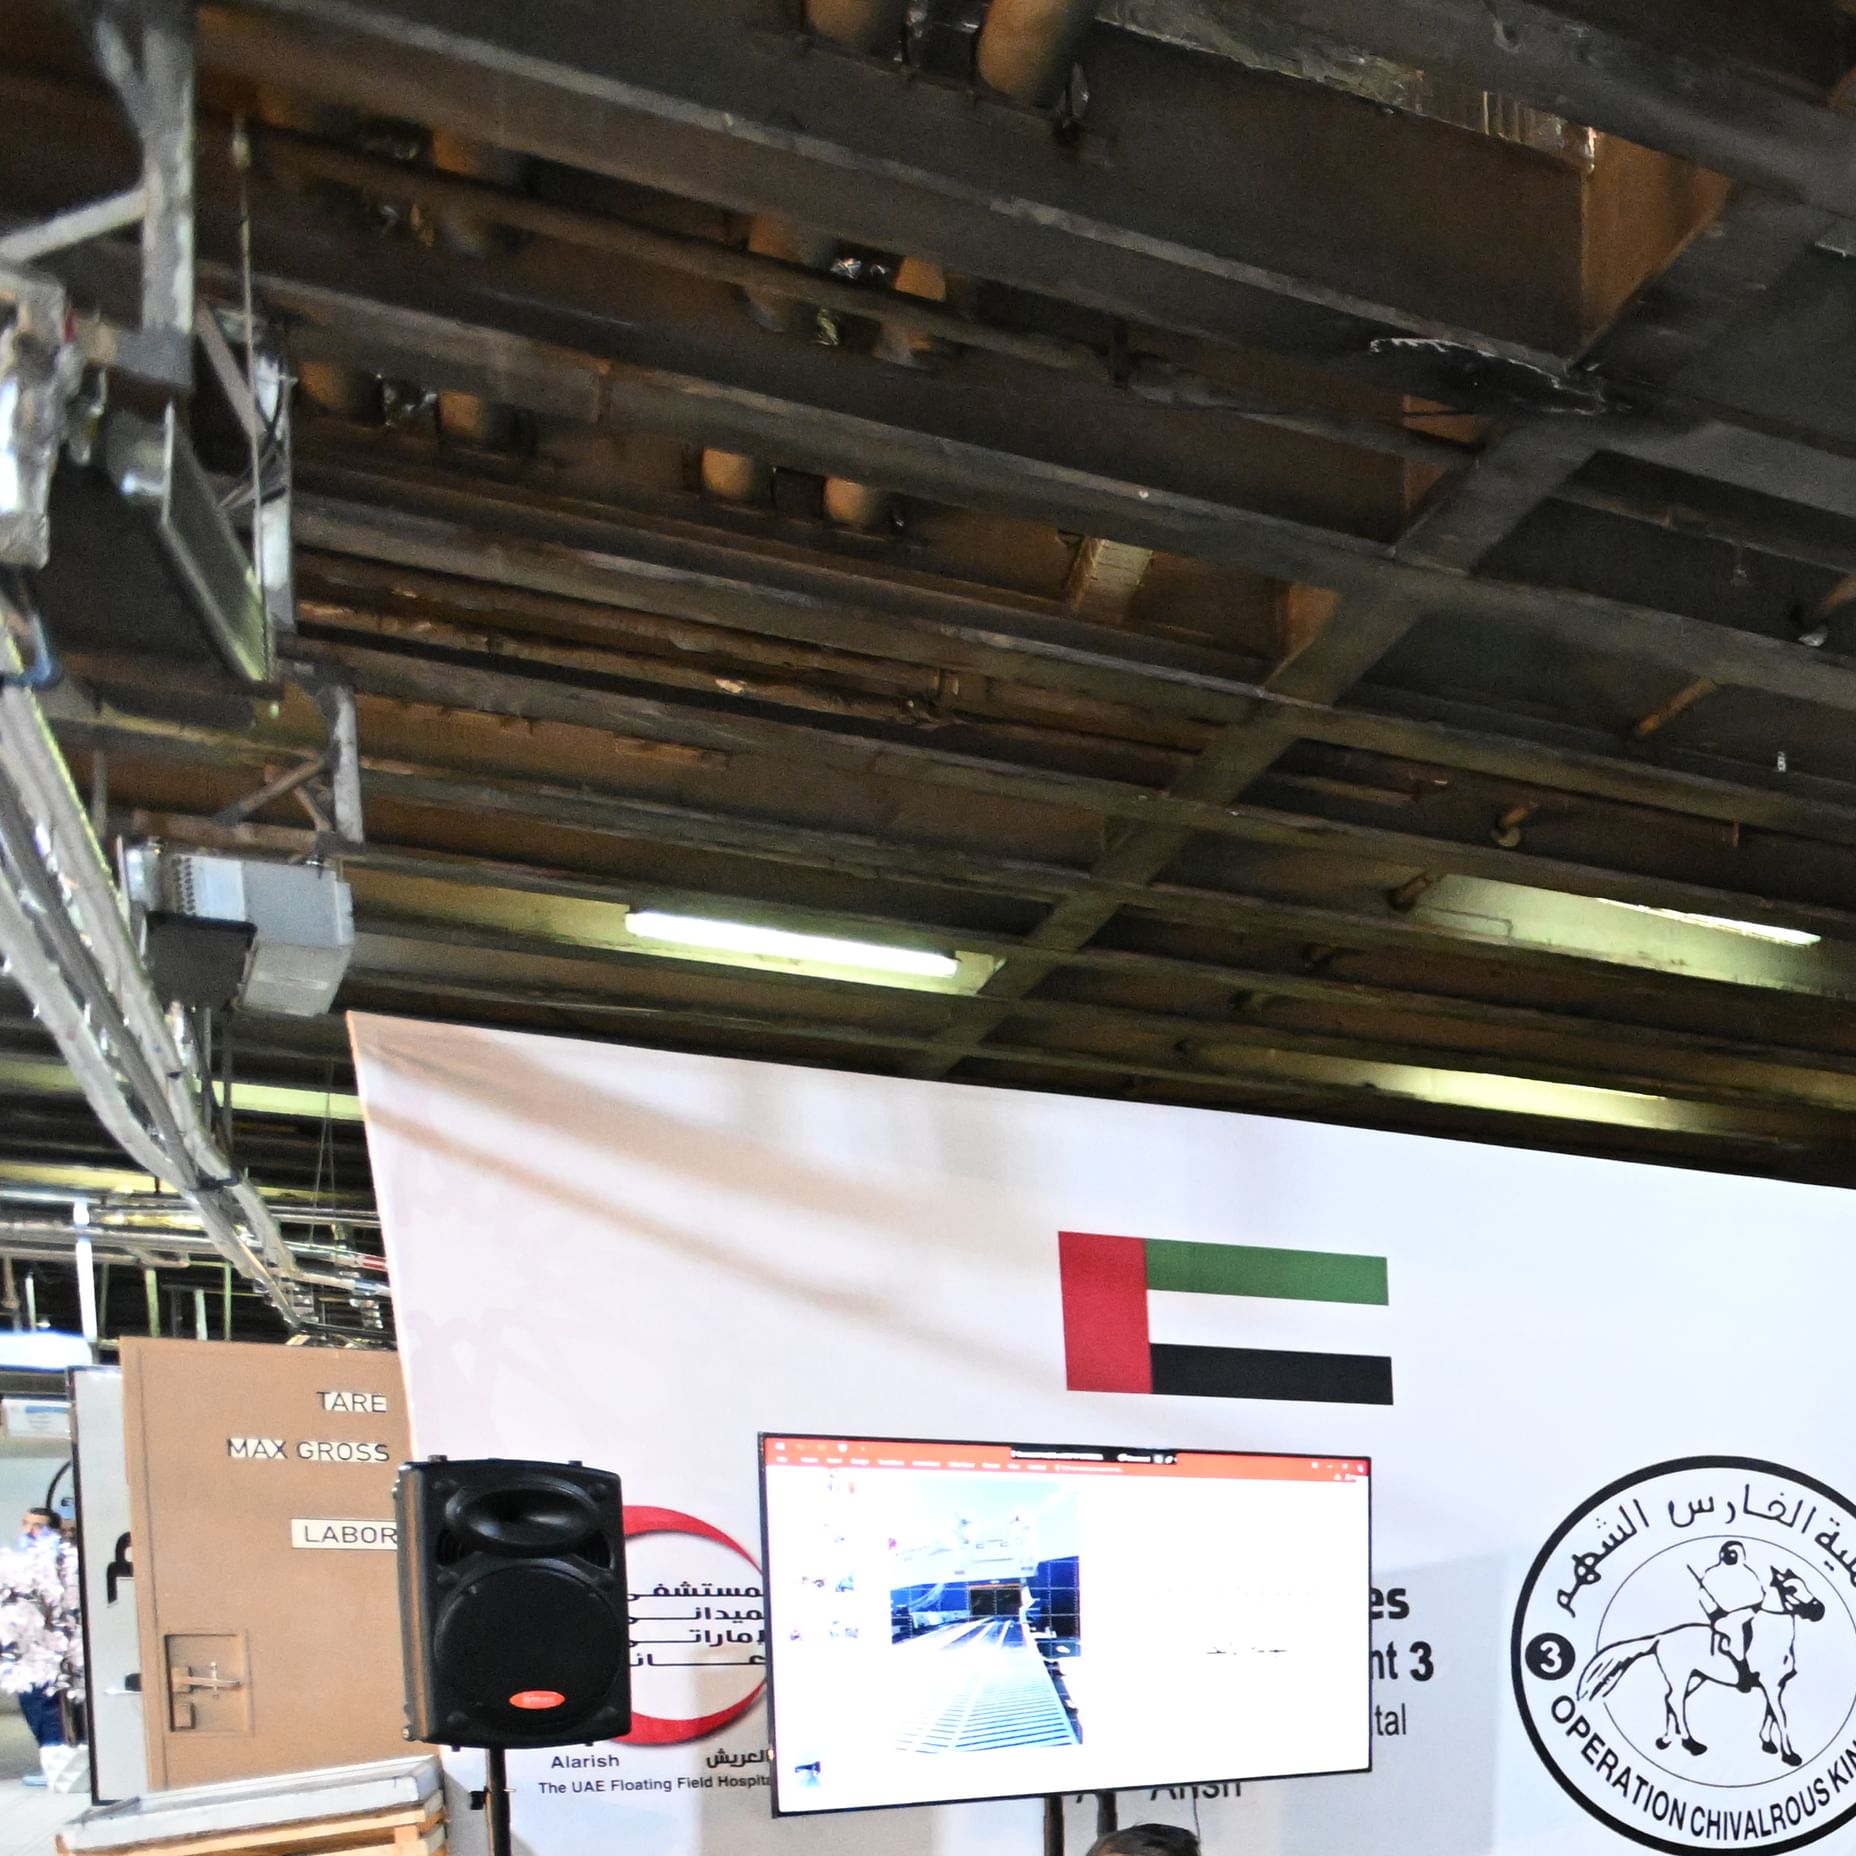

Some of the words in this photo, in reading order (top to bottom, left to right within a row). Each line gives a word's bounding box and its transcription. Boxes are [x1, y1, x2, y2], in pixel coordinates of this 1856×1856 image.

[316, 1391, 387, 1413] TARE
[227, 1439, 289, 1459] MAX
[296, 1441, 390, 1462] GROSS
[1668, 1483, 1817, 1534] الفارس
[304, 1524, 398, 1545] LABOR
[1556, 1498, 1650, 1618] الشهم
[1409, 1641, 1434, 1682] 3
[1539, 1640, 1562, 1673] 3
[551, 1754, 620, 1769] Alarish
[706, 1748, 771, 1769] العريش
[1551, 1695, 1687, 1831] OPERATION
[1690, 1777, 1831, 1840] CHIVALROUS
[538, 1782, 567, 1794] The
[572, 1780, 604, 1793] UAE
[611, 1778, 672, 1793] Floating
[677, 1776, 713, 1789] Field
[717, 1774, 771, 1790] Hospita
